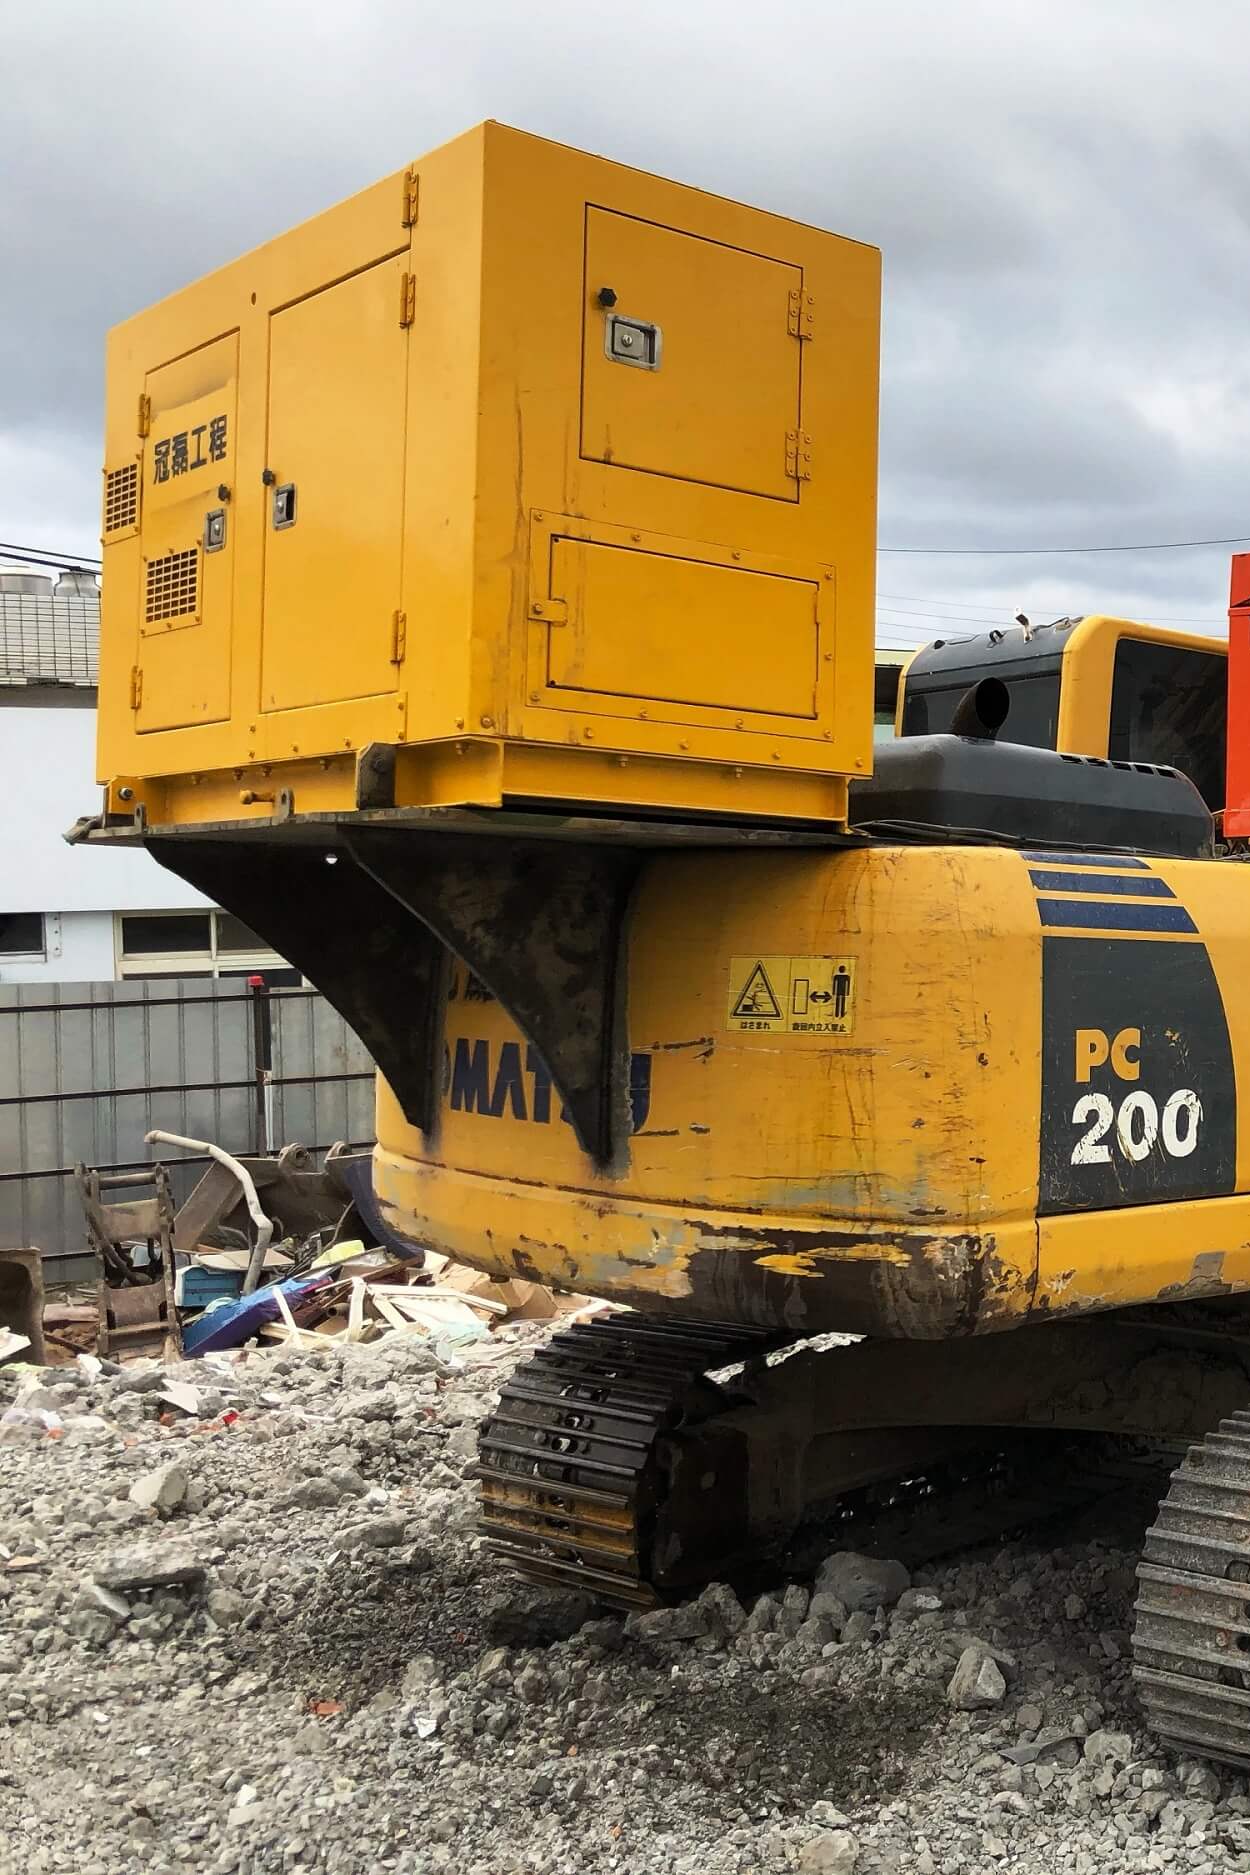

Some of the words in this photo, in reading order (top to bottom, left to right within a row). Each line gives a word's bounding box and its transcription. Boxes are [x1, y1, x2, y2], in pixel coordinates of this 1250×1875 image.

[154, 415, 227, 485] 冠磊工程
[1076, 1028, 1141, 1082] PC
[1071, 1089, 1203, 1165] 200
